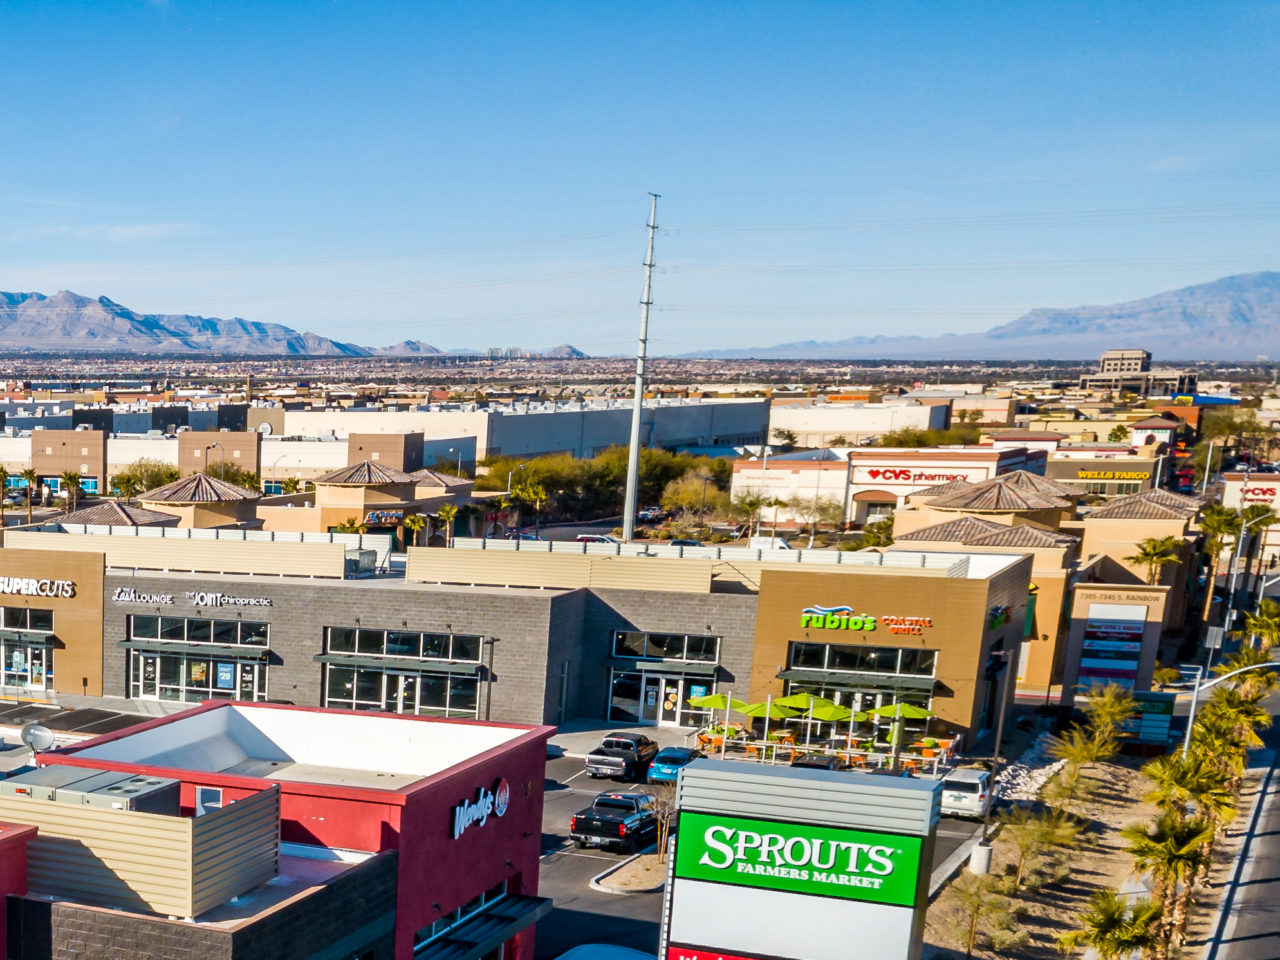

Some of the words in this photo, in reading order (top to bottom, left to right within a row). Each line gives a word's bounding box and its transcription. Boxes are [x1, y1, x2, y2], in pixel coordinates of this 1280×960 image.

[882, 469, 911, 480] CVS
[913, 472, 968, 482] pharmacy
[1078, 471, 1112, 479] WELLS
[1114, 471, 1150, 480] FARGO
[1251, 488, 1276, 496] CVS
[112, 588, 136, 602] Lash
[136, 594, 173, 604] LOUNGE
[193, 592, 222, 606] JOINT
[221, 596, 271, 606] chiropractic
[801, 612, 876, 631] rubio's
[881, 616, 932, 627] COASTAL
[888, 625, 922, 635] GRILL
[455, 787, 494, 840] Wendy's
[699, 825, 895, 876] SPROUTS
[737, 862, 809, 881] FARMERS
[812, 872, 883, 889] MARKET
